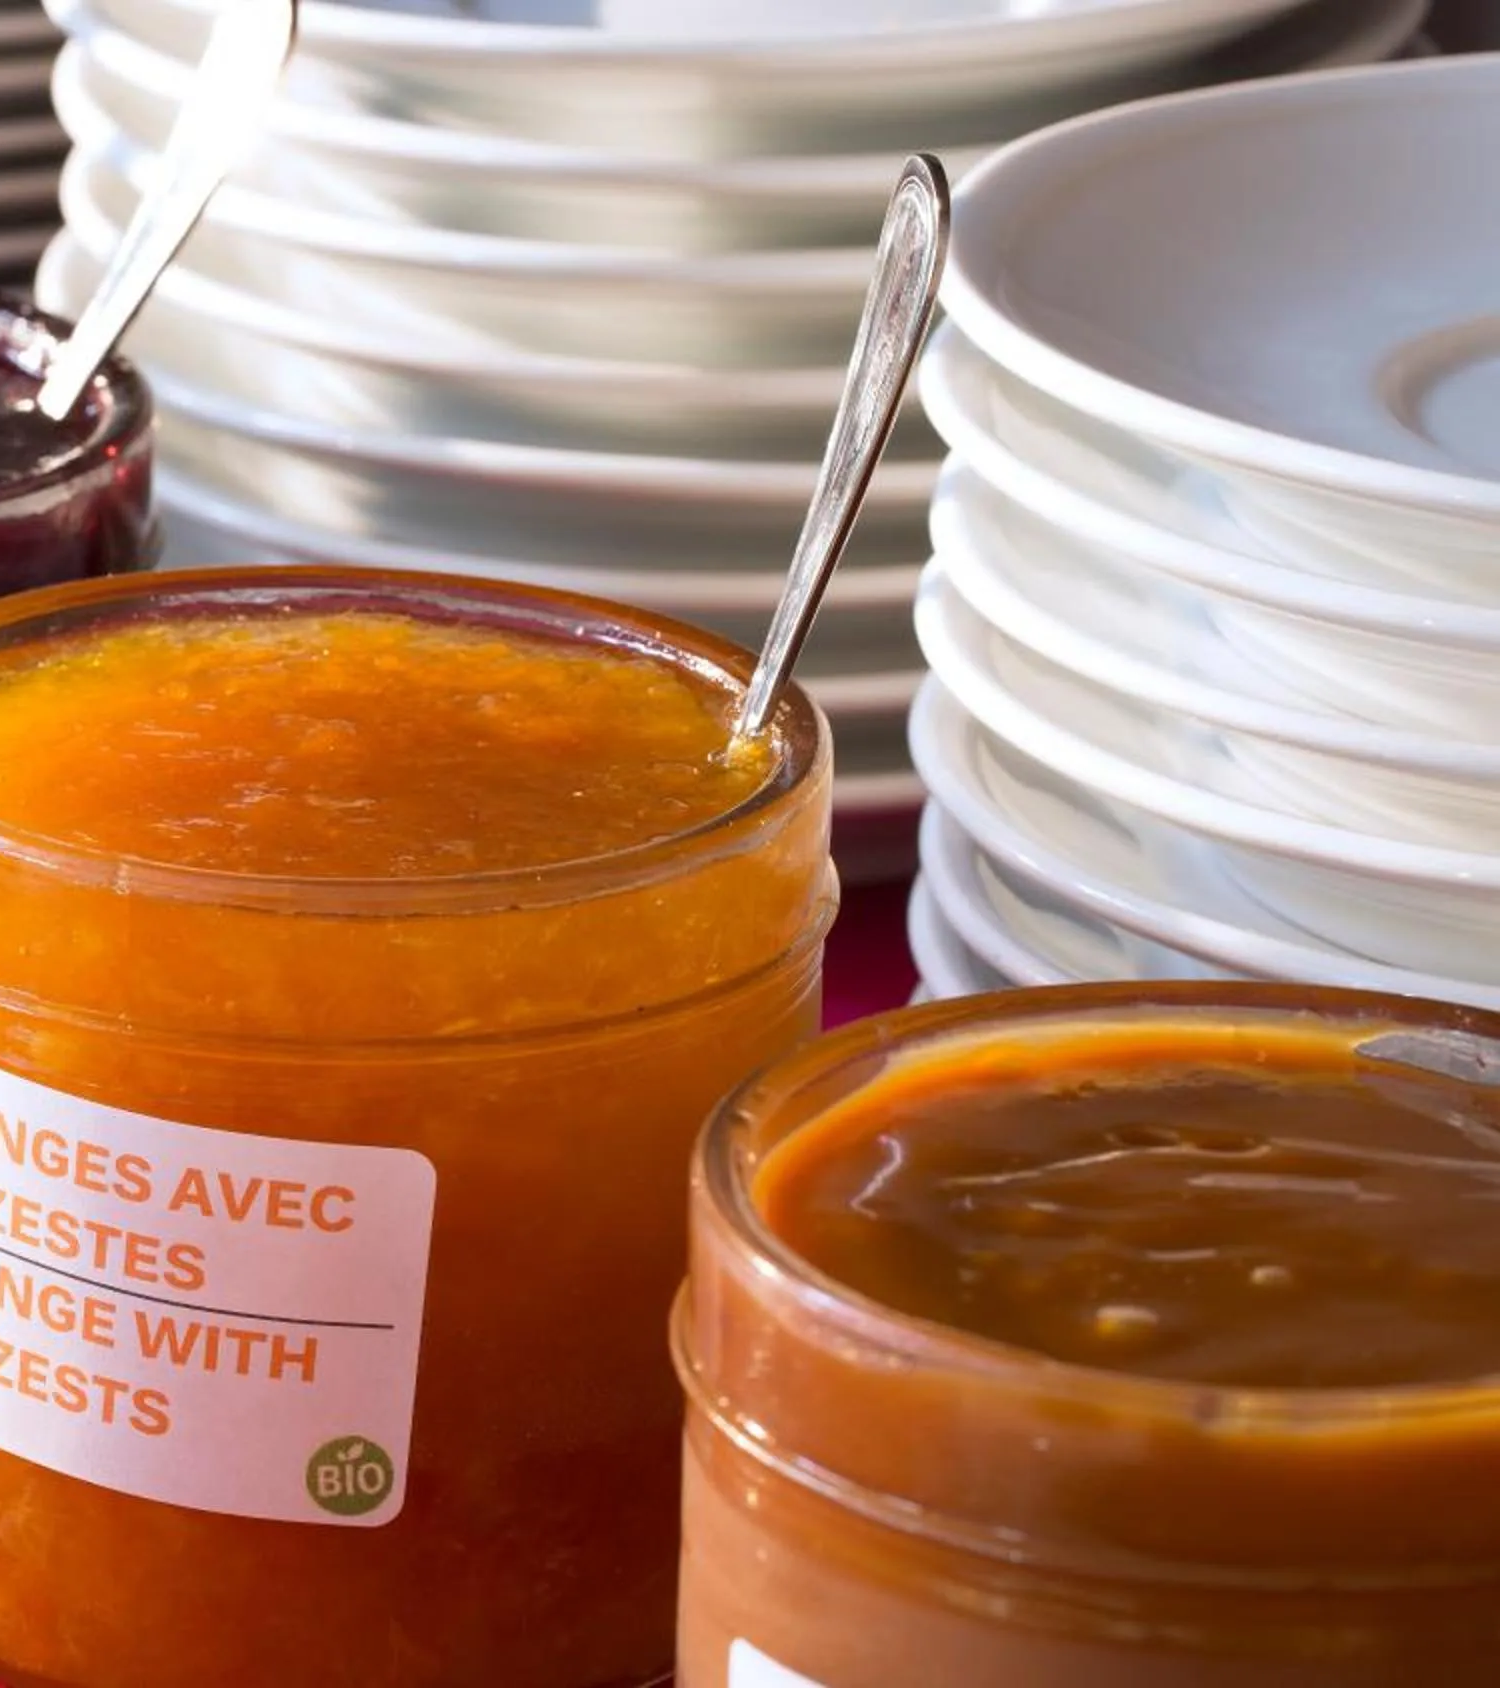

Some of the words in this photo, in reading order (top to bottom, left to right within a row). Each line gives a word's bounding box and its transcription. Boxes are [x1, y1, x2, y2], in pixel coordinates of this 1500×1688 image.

[168, 1167, 356, 1233] AVEC
[134, 1309, 319, 1383] WITH
[316, 1462, 386, 1497] BIO
